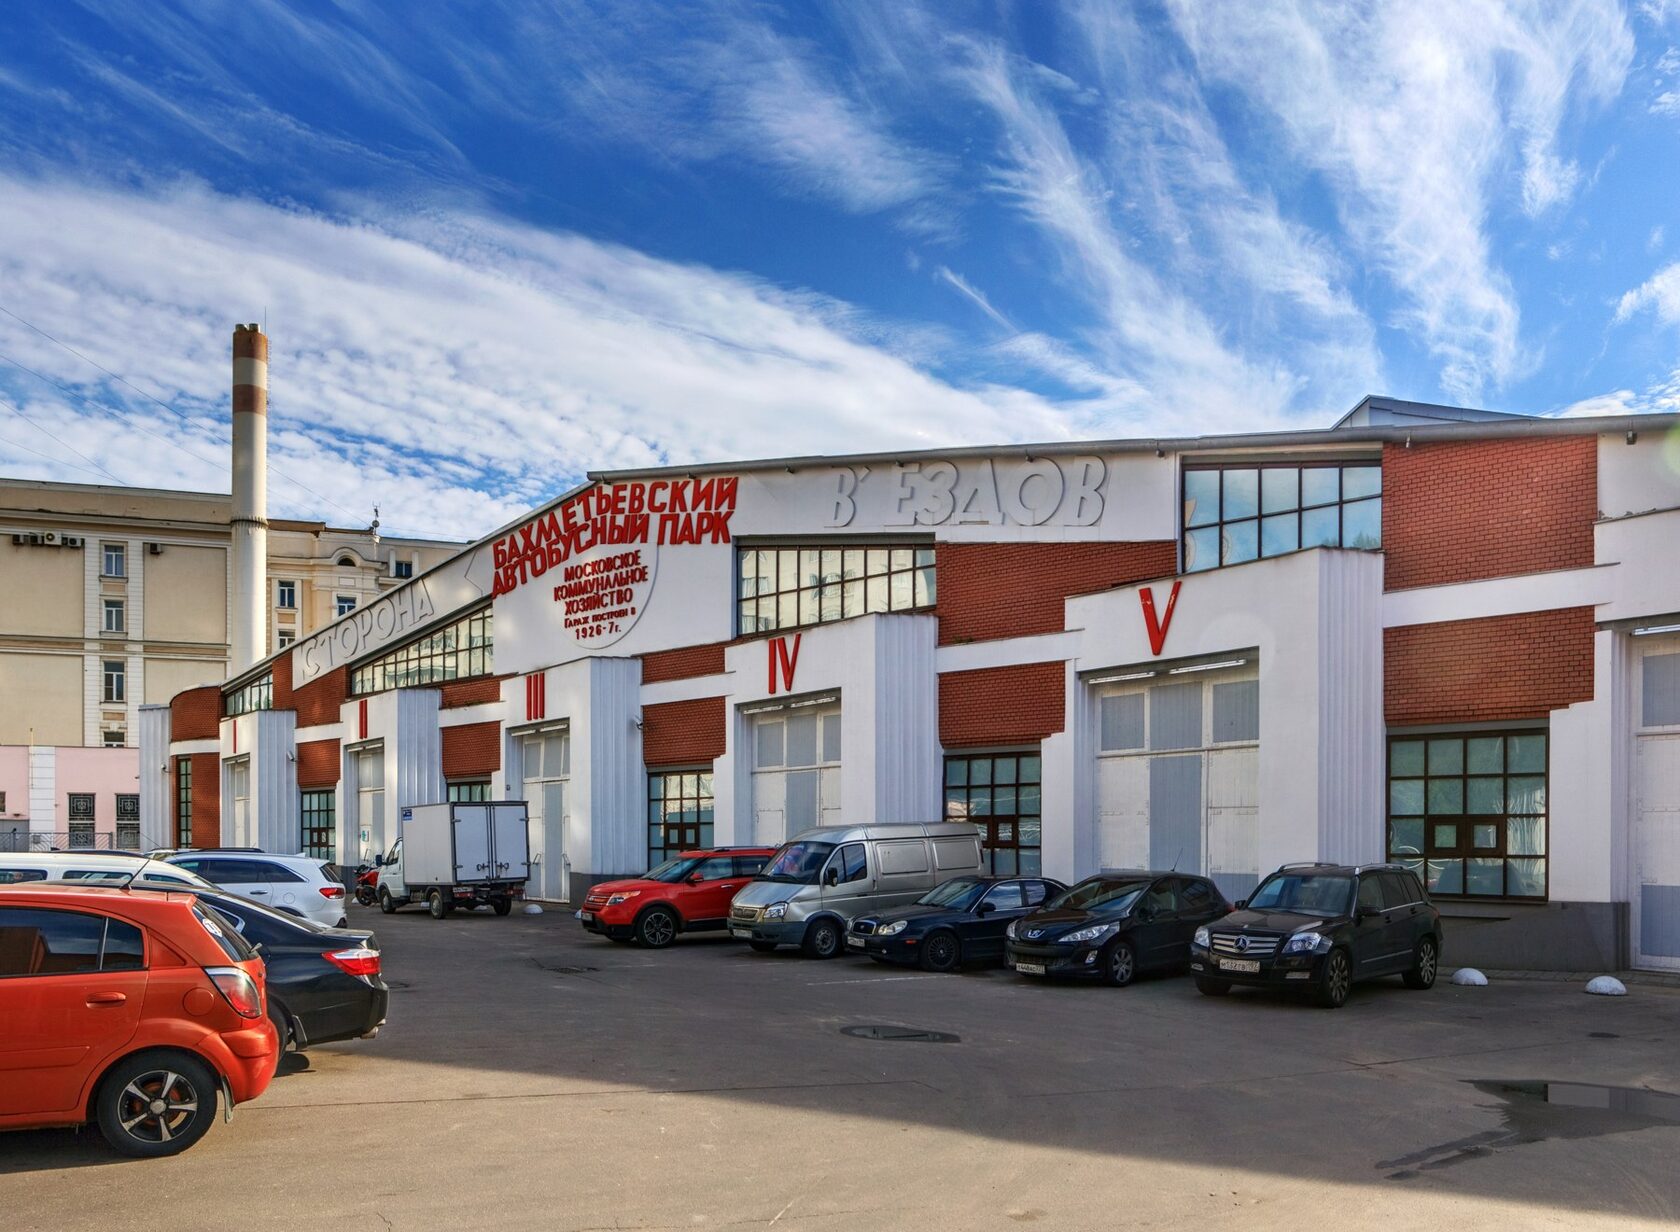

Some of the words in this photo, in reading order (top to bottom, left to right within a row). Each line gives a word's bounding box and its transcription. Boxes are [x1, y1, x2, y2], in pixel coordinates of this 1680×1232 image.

[492, 477, 739, 570] БАХМЕТЬЕВСКИЙ
[491, 513, 650, 600] АВТОБУСНЫЙ
[657, 510, 735, 546] ПАРК
[553, 565, 649, 602] КОММУНАЛЬНОЕ
[564, 550, 642, 582] МОСКОВСКОЕ
[302, 578, 436, 679] СТОРОНА
[564, 588, 633, 615] ХОЗЯЙСТВО
[1138, 580, 1182, 656] V
[767, 633, 802, 694] IV
[525, 671, 545, 721] III
